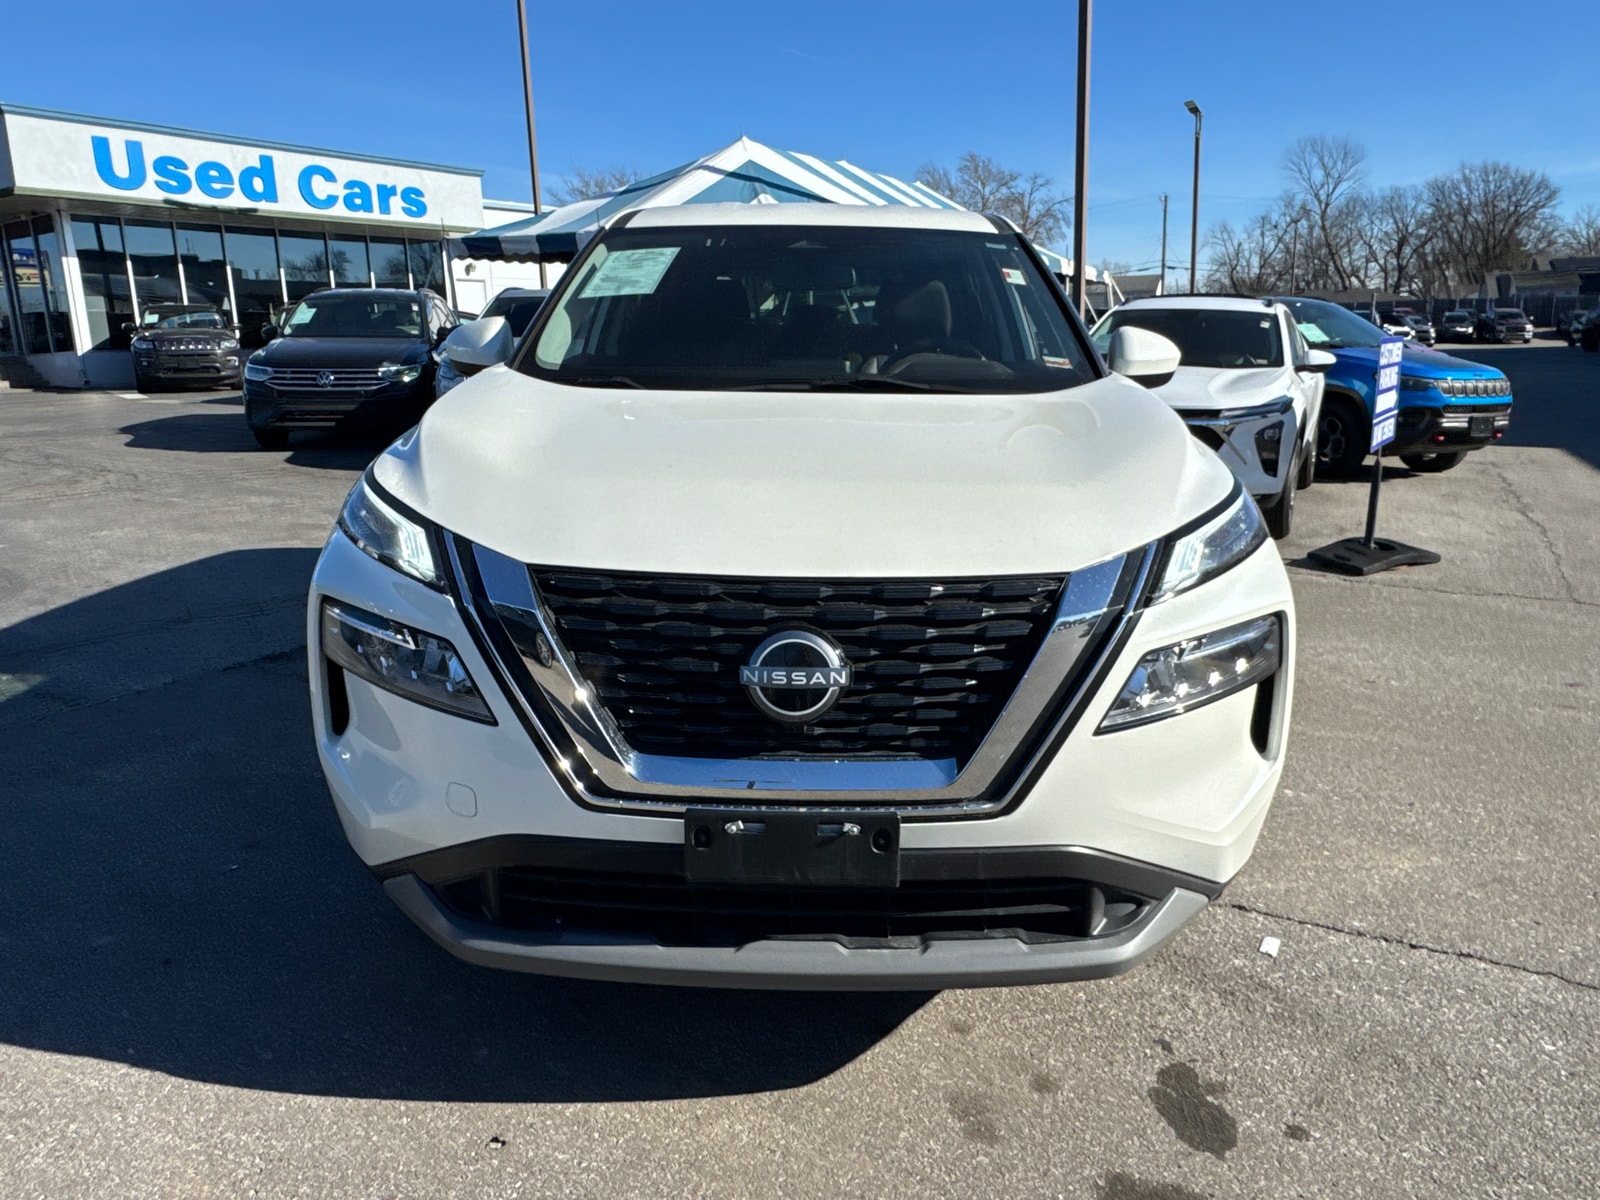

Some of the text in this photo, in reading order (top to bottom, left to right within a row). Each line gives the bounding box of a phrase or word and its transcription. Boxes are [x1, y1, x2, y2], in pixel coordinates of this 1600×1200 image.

[91, 135, 428, 218] Used Cars
[743, 669, 846, 685] NISSAN
